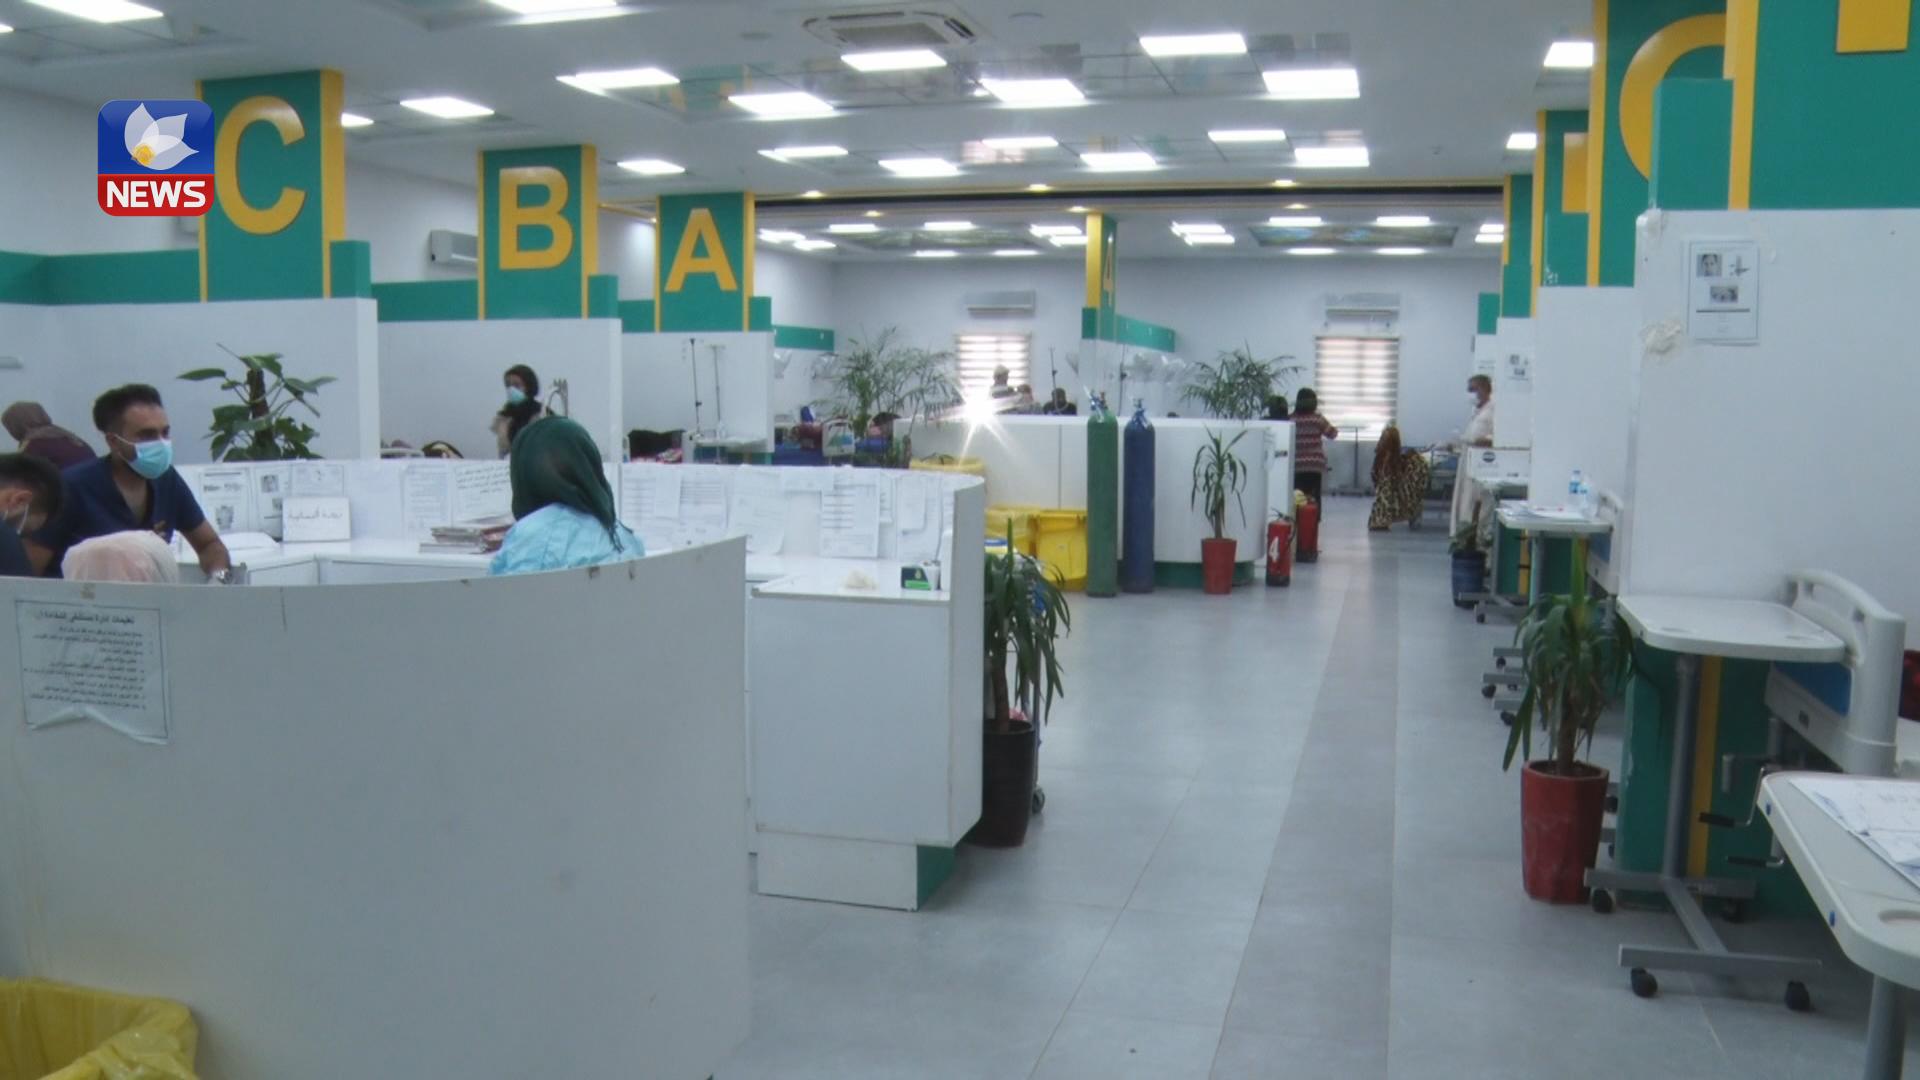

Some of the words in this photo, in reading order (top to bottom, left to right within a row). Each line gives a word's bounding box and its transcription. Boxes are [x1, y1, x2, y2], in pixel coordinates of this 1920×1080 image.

[215, 96, 306, 235] C
[499, 166, 573, 270] B
[664, 208, 738, 293] A
[1268, 535, 1279, 563] 4
